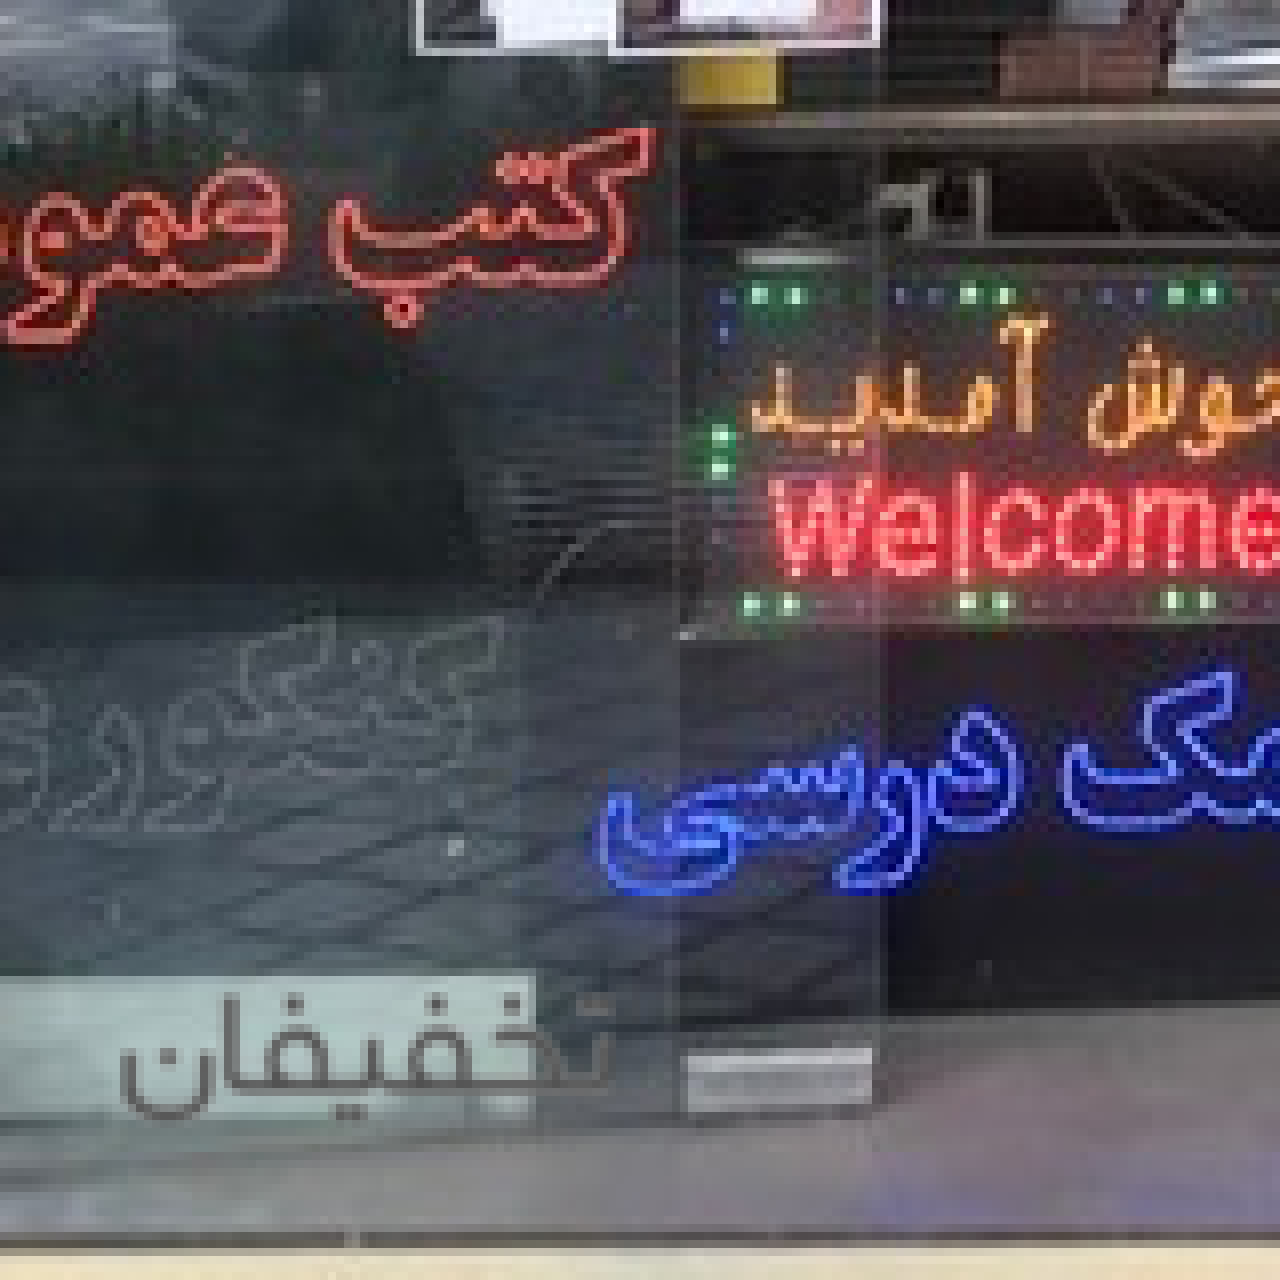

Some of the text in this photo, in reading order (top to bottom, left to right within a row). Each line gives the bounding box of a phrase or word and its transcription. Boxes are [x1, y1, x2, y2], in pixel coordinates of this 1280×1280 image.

[328, 126, 656, 328] کتب
[748, 310, 1052, 456] آمدید
[596, 708, 1025, 898] درسی
